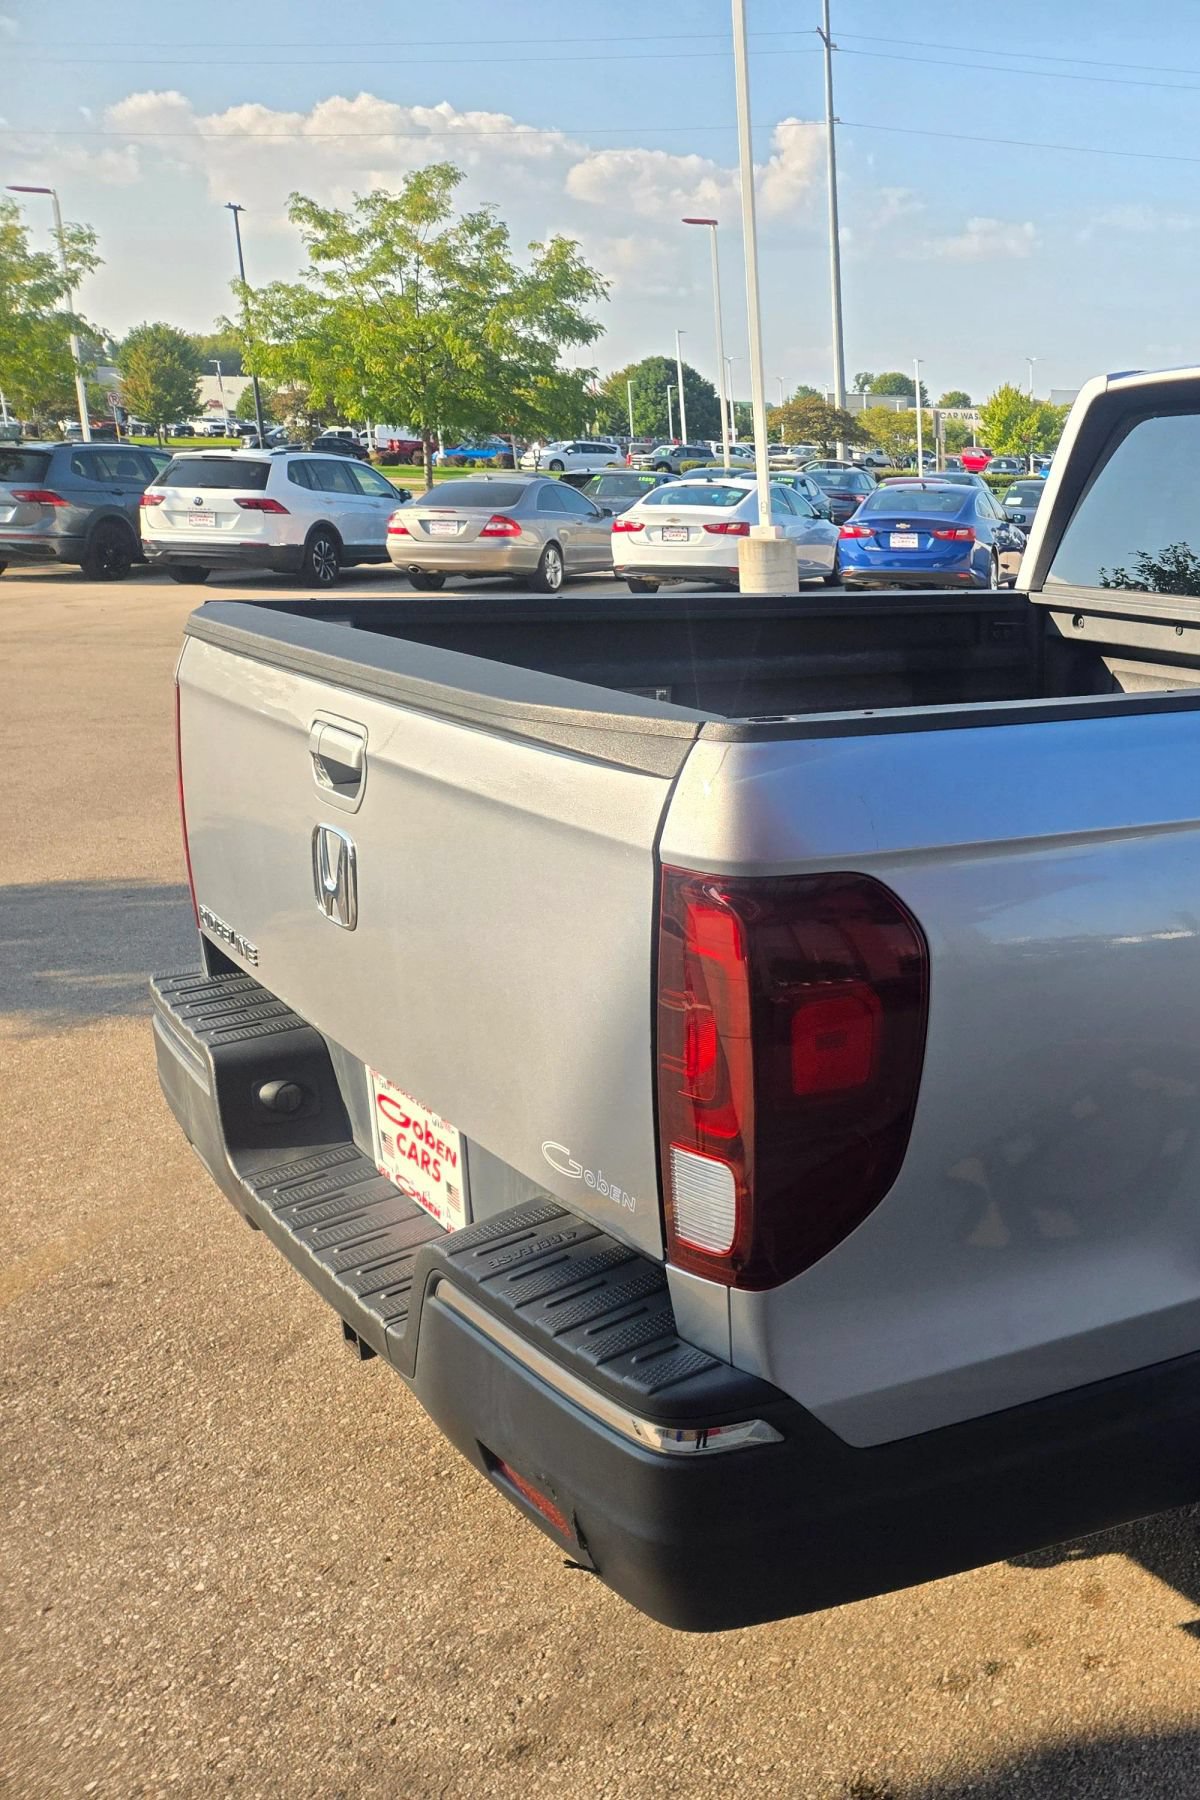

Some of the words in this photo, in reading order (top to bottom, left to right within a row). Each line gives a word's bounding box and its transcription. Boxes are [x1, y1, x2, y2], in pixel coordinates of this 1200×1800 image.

[939, 411, 959, 420] CAR
[961, 412, 979, 421] WAS
[199, 904, 259, 968] RIDGELINE
[396, 1132, 441, 1183] CARS
[487, 1234, 563, 1269] RELEASE
